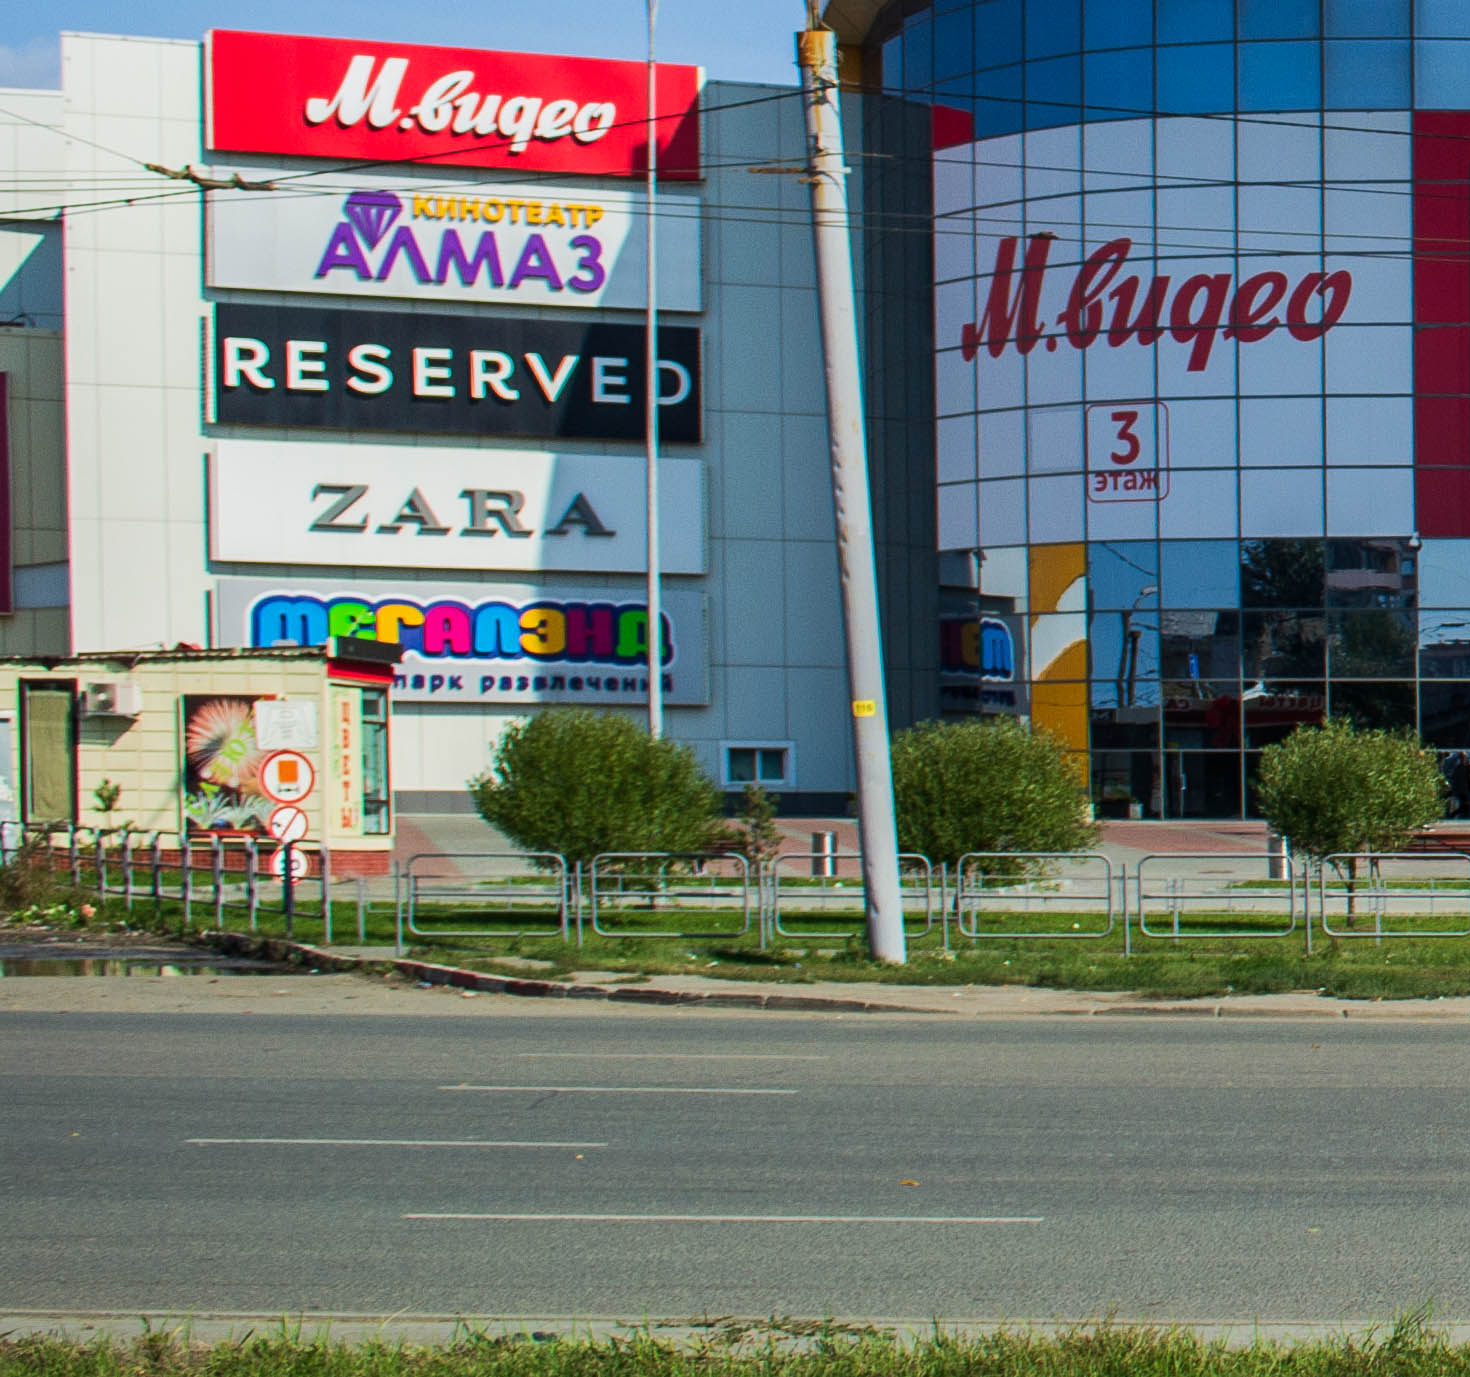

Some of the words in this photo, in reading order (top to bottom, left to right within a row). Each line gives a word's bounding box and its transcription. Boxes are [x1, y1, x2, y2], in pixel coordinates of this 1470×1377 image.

[306, 55, 616, 152] М.видео
[412, 194, 604, 228] КИНОТЕАТР
[313, 221, 606, 293] АЛМАЗ
[962, 235, 1352, 371] М.видео
[223, 335, 691, 407] RESERVED
[1109, 410, 1141, 465] 3
[310, 481, 617, 538] ZARA
[1093, 470, 1160, 493] этаж
[394, 674, 464, 693] парк
